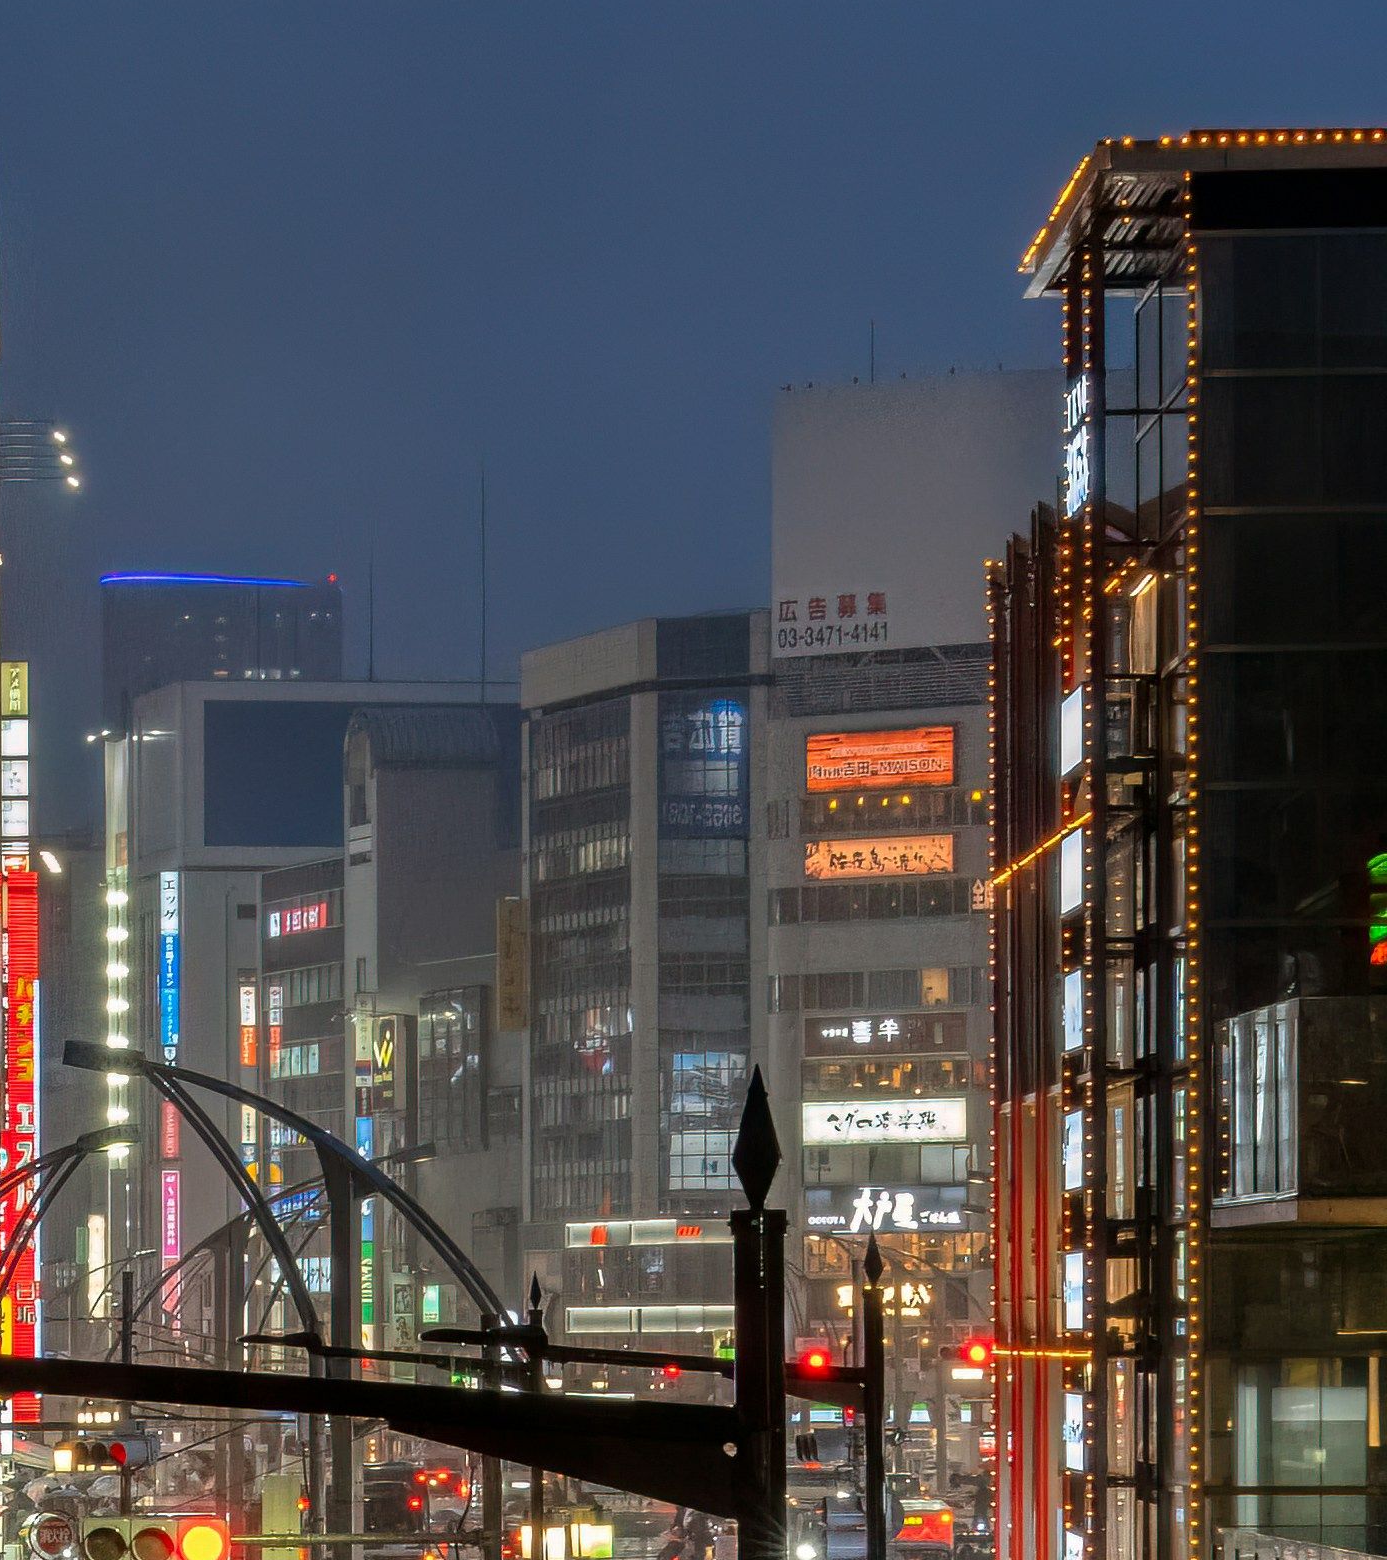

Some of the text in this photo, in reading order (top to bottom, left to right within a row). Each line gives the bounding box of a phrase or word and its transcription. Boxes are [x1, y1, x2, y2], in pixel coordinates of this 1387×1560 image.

[779, 593, 887, 623] 広告募集
[778, 622, 888, 649] 03-3471-4141
[15, 976, 35, 1080] パチンコ
